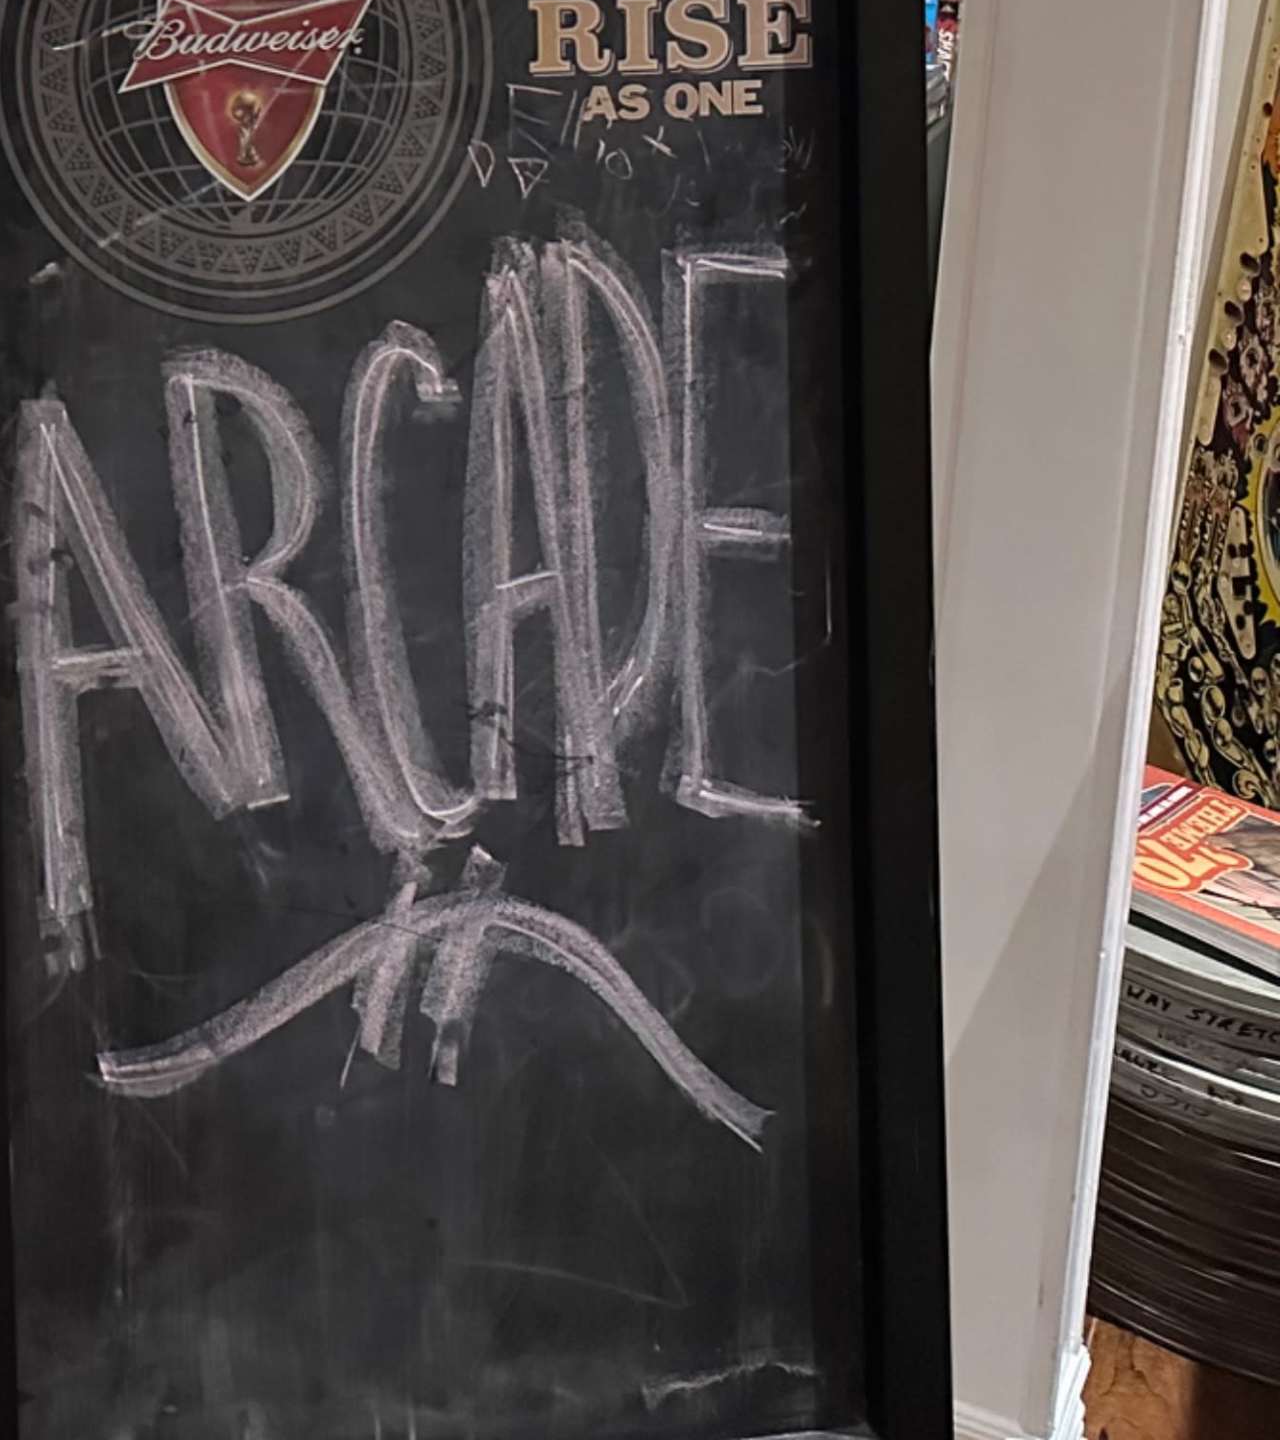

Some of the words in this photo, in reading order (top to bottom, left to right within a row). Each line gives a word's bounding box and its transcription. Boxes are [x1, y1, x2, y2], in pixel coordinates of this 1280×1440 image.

[124, 17, 367, 65] Budweiser
[582, 83, 652, 123] AS
[663, 82, 765, 122] ONE
[13, 210, 820, 965] ARCADE
